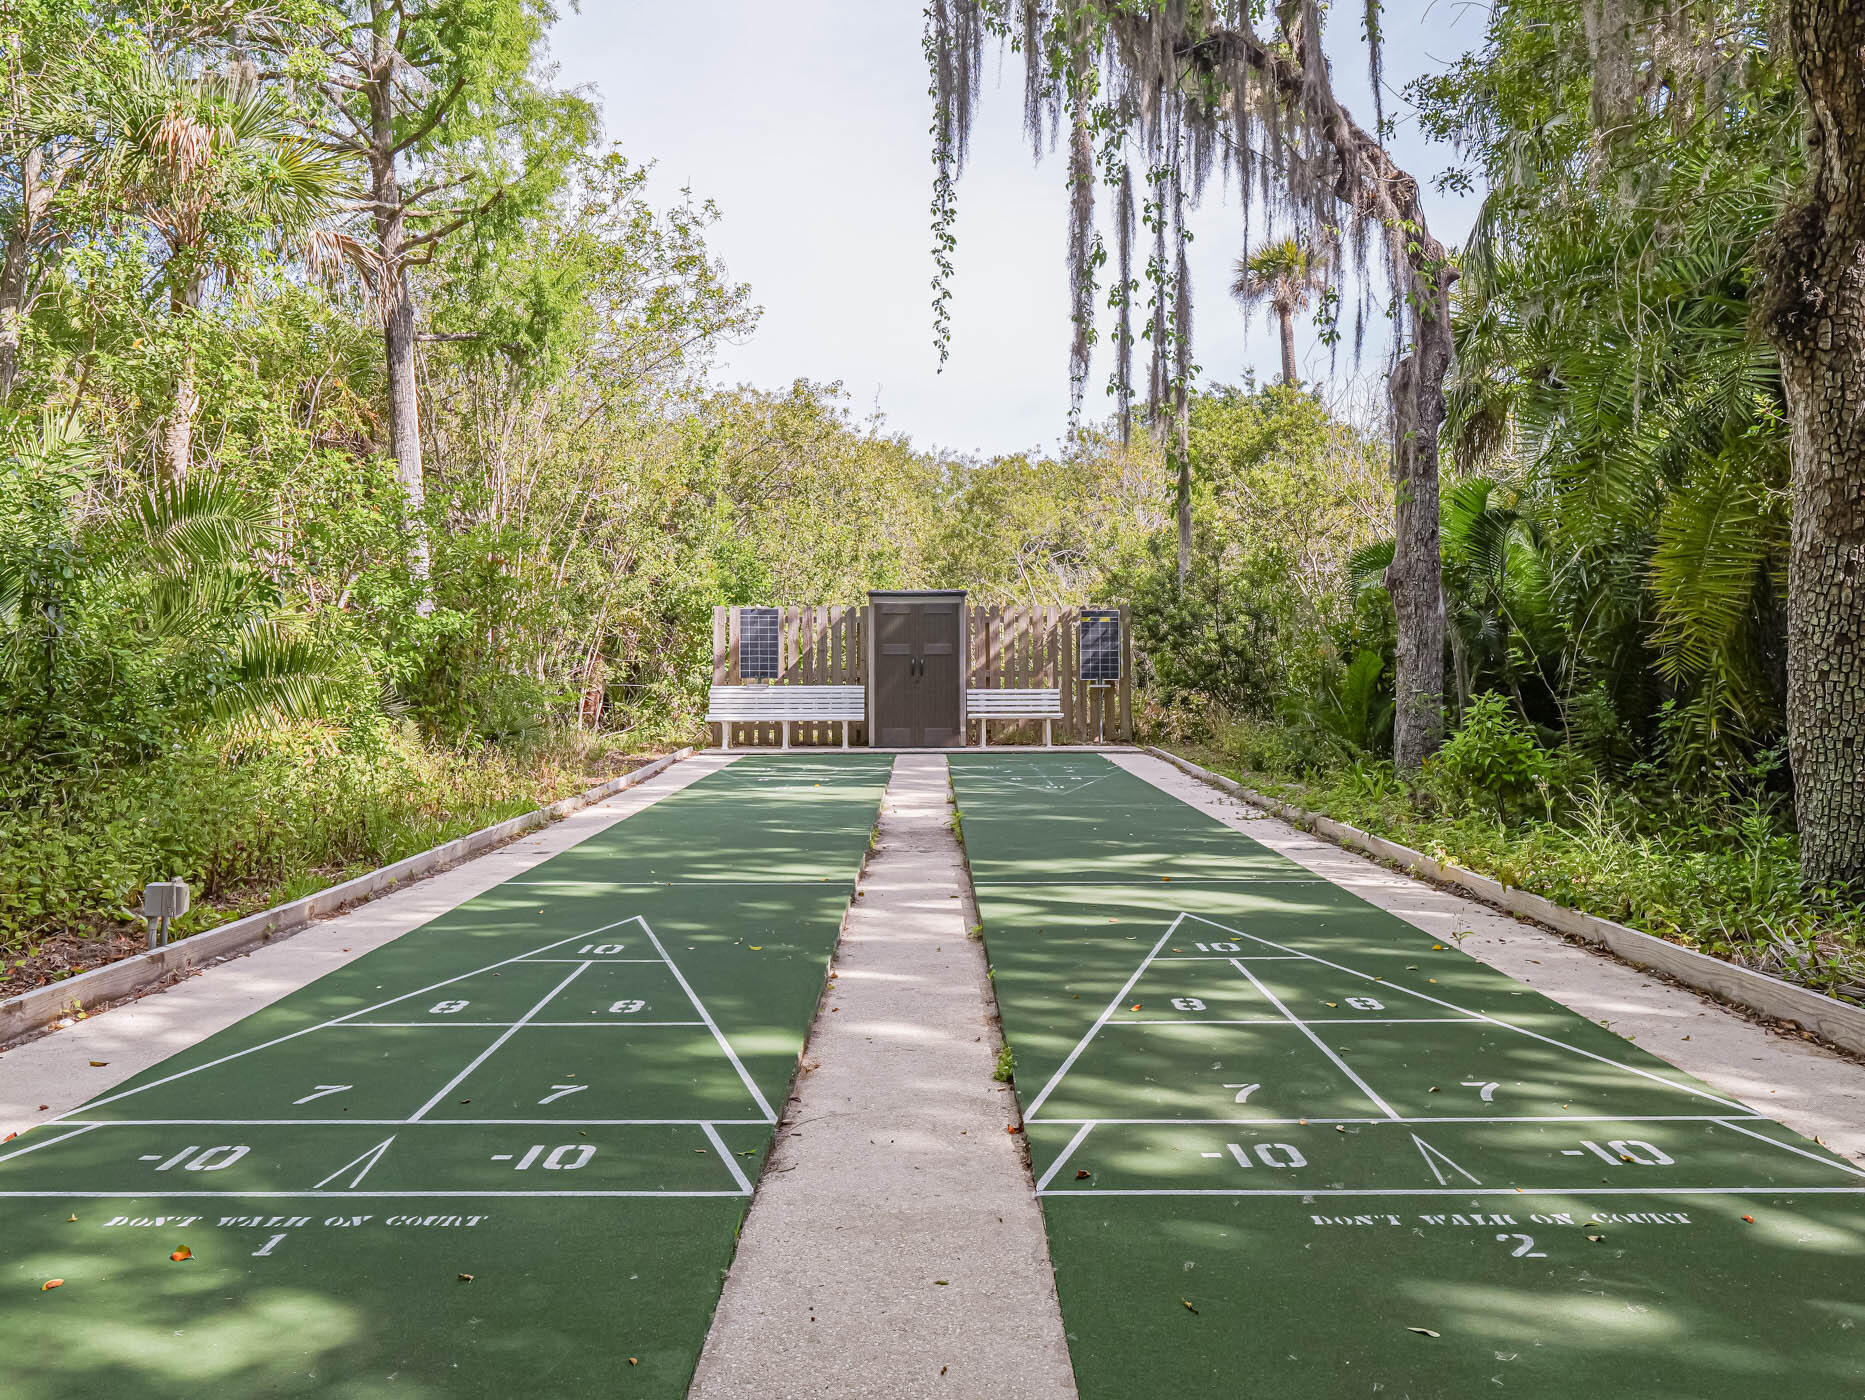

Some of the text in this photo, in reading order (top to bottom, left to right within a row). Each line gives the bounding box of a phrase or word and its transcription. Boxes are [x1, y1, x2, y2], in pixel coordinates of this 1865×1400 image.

[578, 944, 625, 954] 10
[1195, 942, 1241, 952] 10
[429, 1000, 470, 1014] 8
[608, 999, 646, 1013] 8
[1170, 997, 1207, 1011] 8
[1344, 997, 1385, 1011] 8
[292, 1084, 353, 1105] 7
[537, 1084, 589, 1105] 7
[1223, 1083, 1261, 1104] 7
[1460, 1081, 1501, 1102] 7
[138, 1145, 251, 1171] -10
[490, 1144, 597, 1170] -10
[1200, 1143, 1308, 1168] -10
[1560, 1139, 1675, 1166] -10
[103, 1216, 203, 1227] DON'T
[324, 1215, 374, 1227] ON
[385, 1215, 489, 1227] COURT
[1310, 1215, 1401, 1226] DON'T
[1529, 1213, 1575, 1225] ON
[1591, 1212, 1692, 1225] COURT
[251, 1233, 287, 1257] 1
[1495, 1233, 1548, 1258] 2
